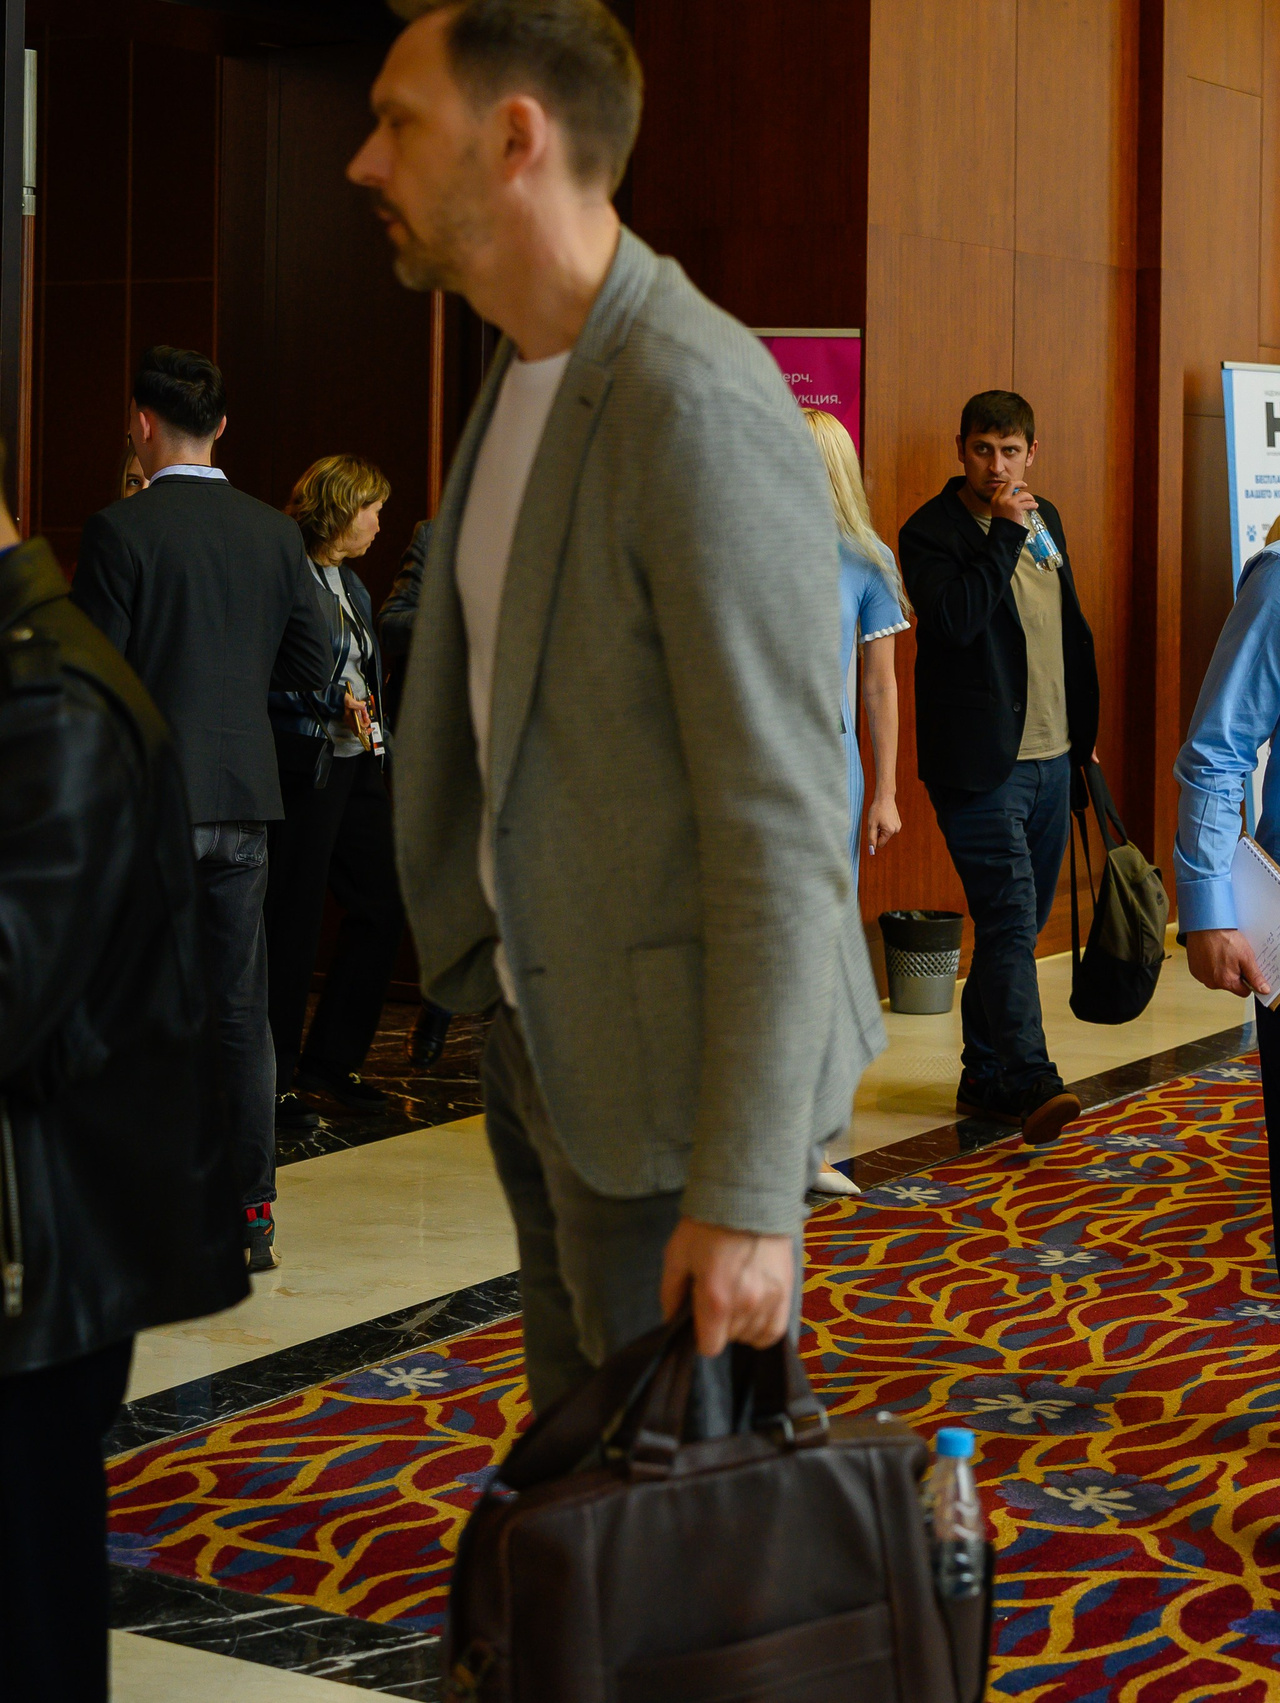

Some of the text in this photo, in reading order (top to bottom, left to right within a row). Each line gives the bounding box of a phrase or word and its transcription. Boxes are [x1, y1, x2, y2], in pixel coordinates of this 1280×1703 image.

[782, 373, 813, 385] ерч.
[793, 394, 842, 405] укция.
[1245, 489, 1272, 499] ВАШЕГО
